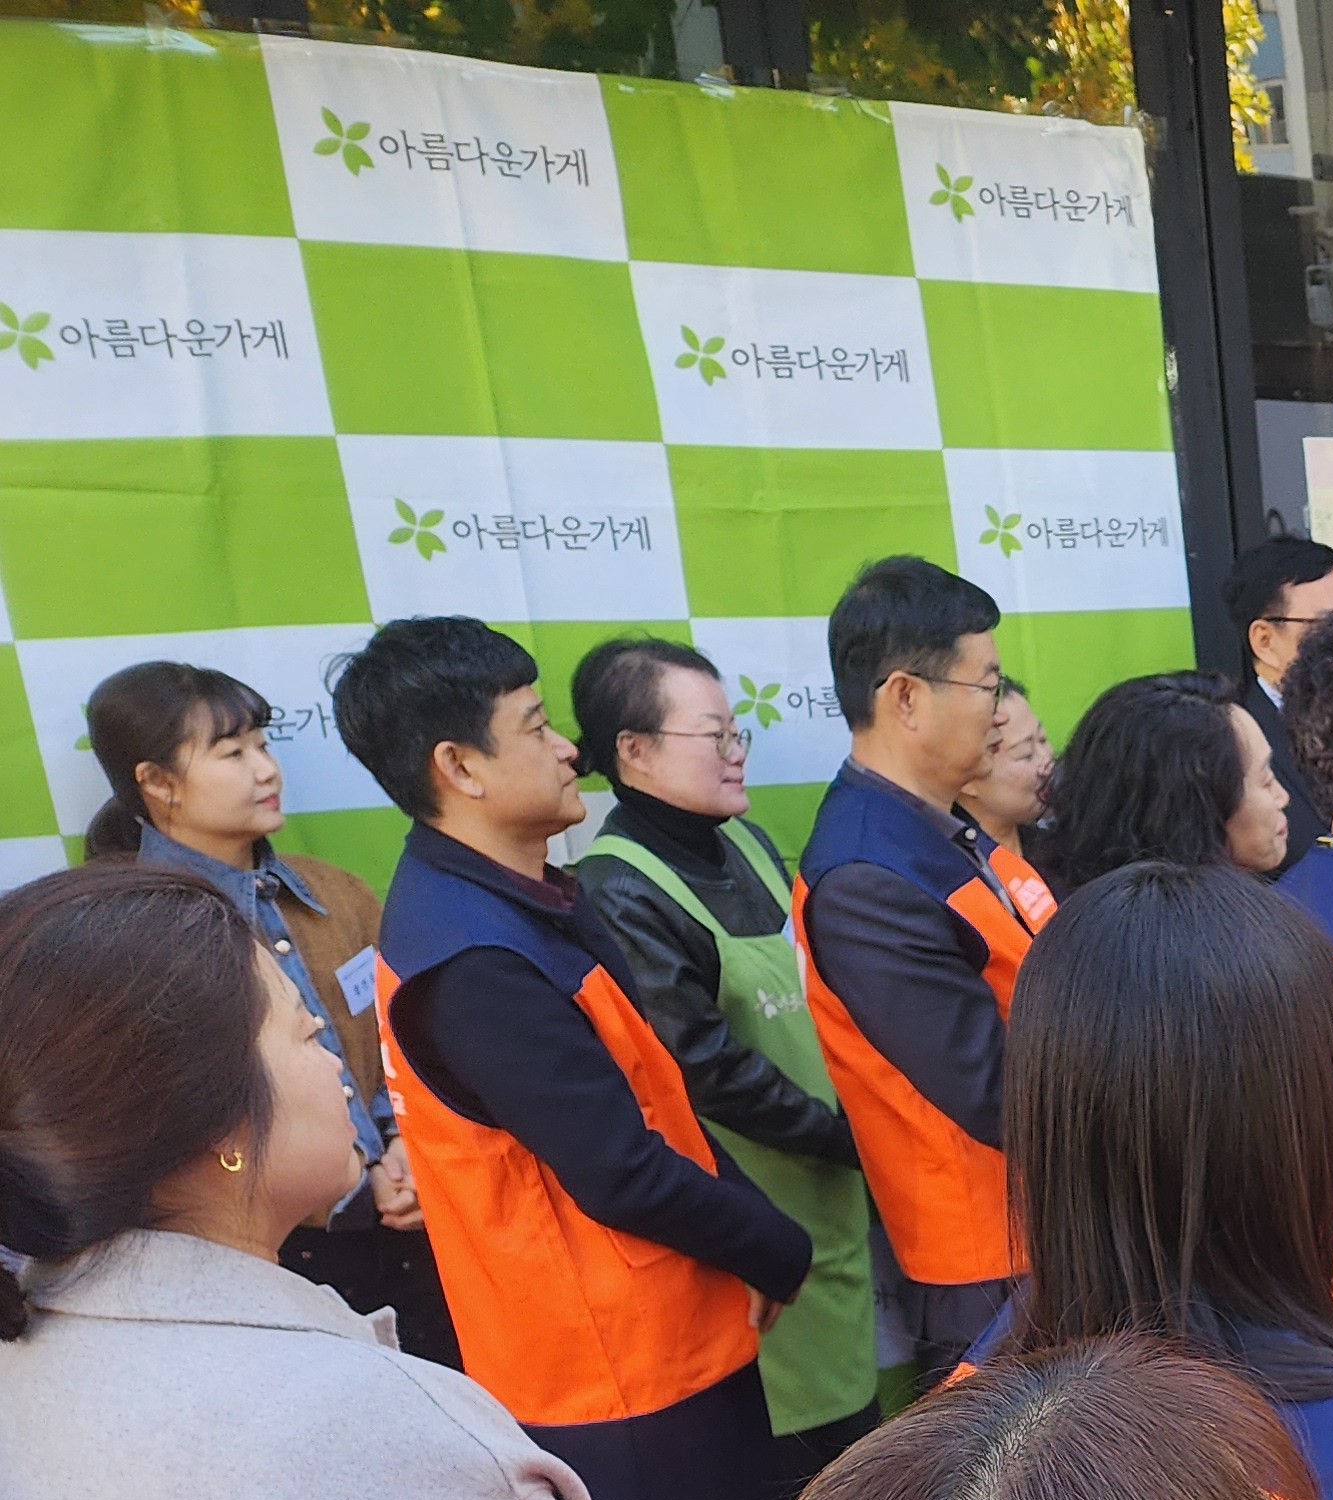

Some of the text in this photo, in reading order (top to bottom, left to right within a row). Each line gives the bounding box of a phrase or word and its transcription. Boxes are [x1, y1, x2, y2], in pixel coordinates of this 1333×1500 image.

[378, 129, 591, 188] 아름다운가게
[978, 182, 1136, 227] 아름다운가게
[59, 317, 289, 360] 아름다운가게
[731, 342, 911, 384] 아름다운가게
[452, 513, 653, 552] 아름다운가게
[1026, 517, 1169, 550] 아름다운가게
